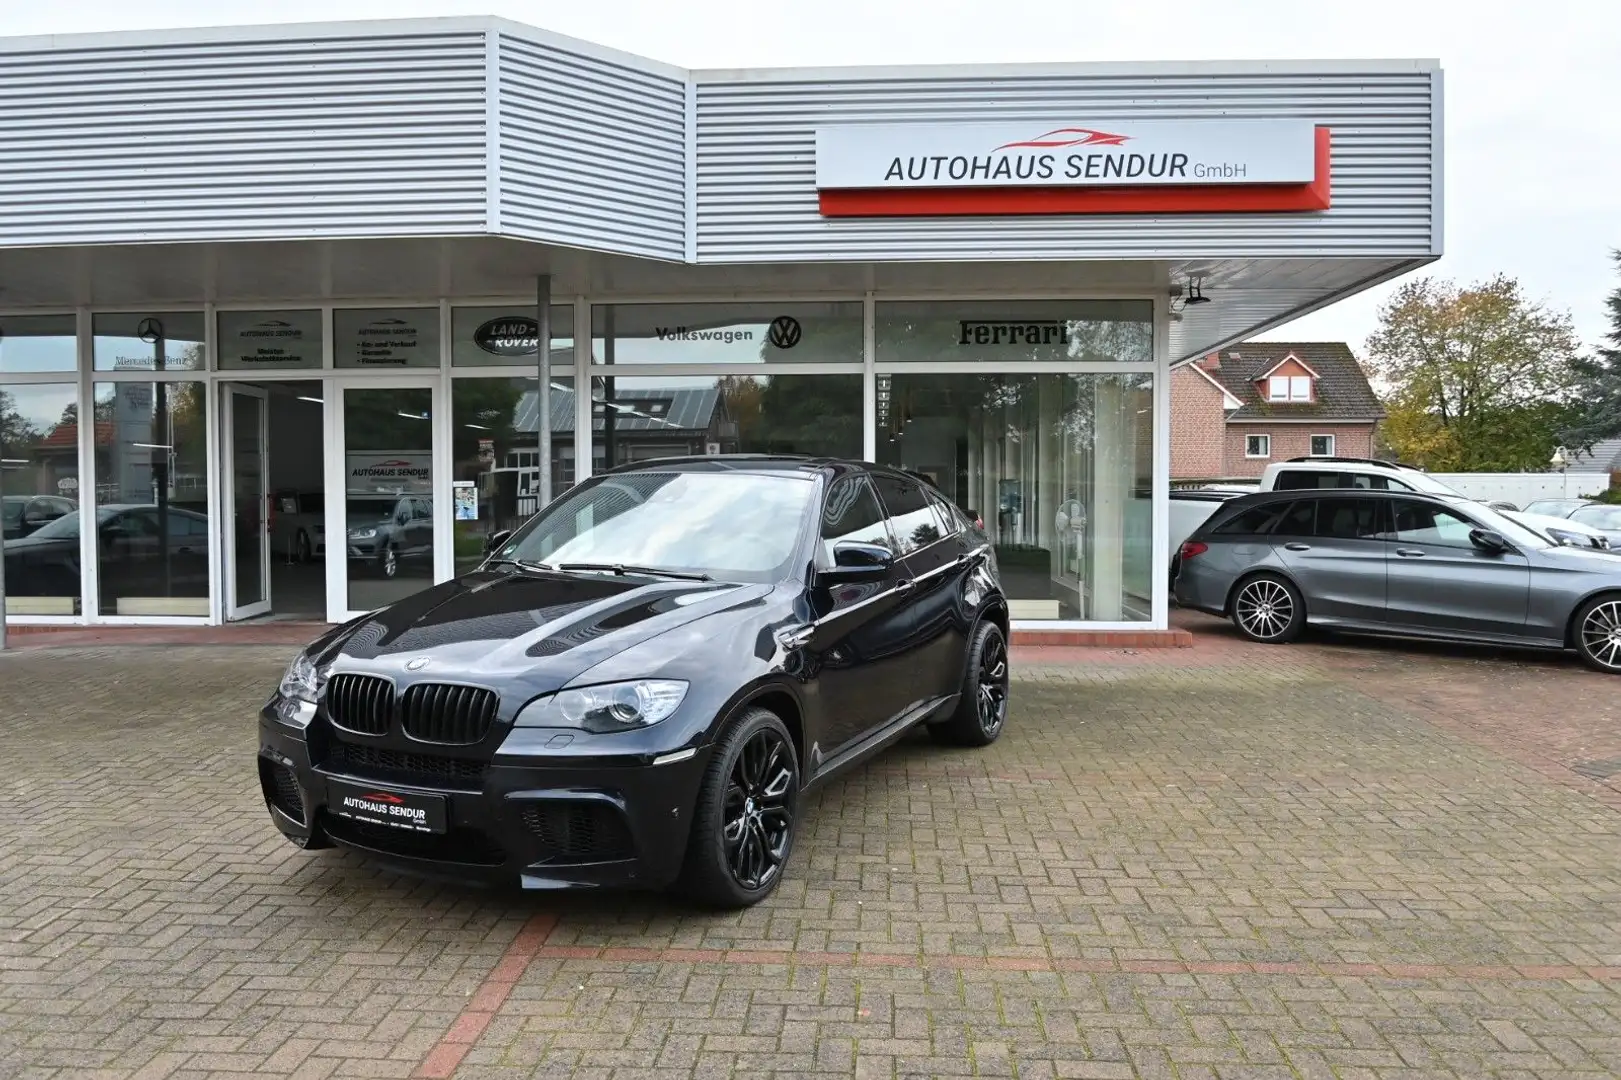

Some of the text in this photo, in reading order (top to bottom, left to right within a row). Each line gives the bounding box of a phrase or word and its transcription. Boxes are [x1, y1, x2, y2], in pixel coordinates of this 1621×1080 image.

[884, 152, 1247, 181] AUTOHAUS SENDUR GmbH
[494, 337, 539, 348] ROVER
[655, 326, 753, 344] Volkswagen
[958, 319, 1068, 345] Ferrari
[352, 467, 429, 477] AUTOHAUS SENDUR
[343, 796, 426, 820] AUTOHAUS SENDUR
